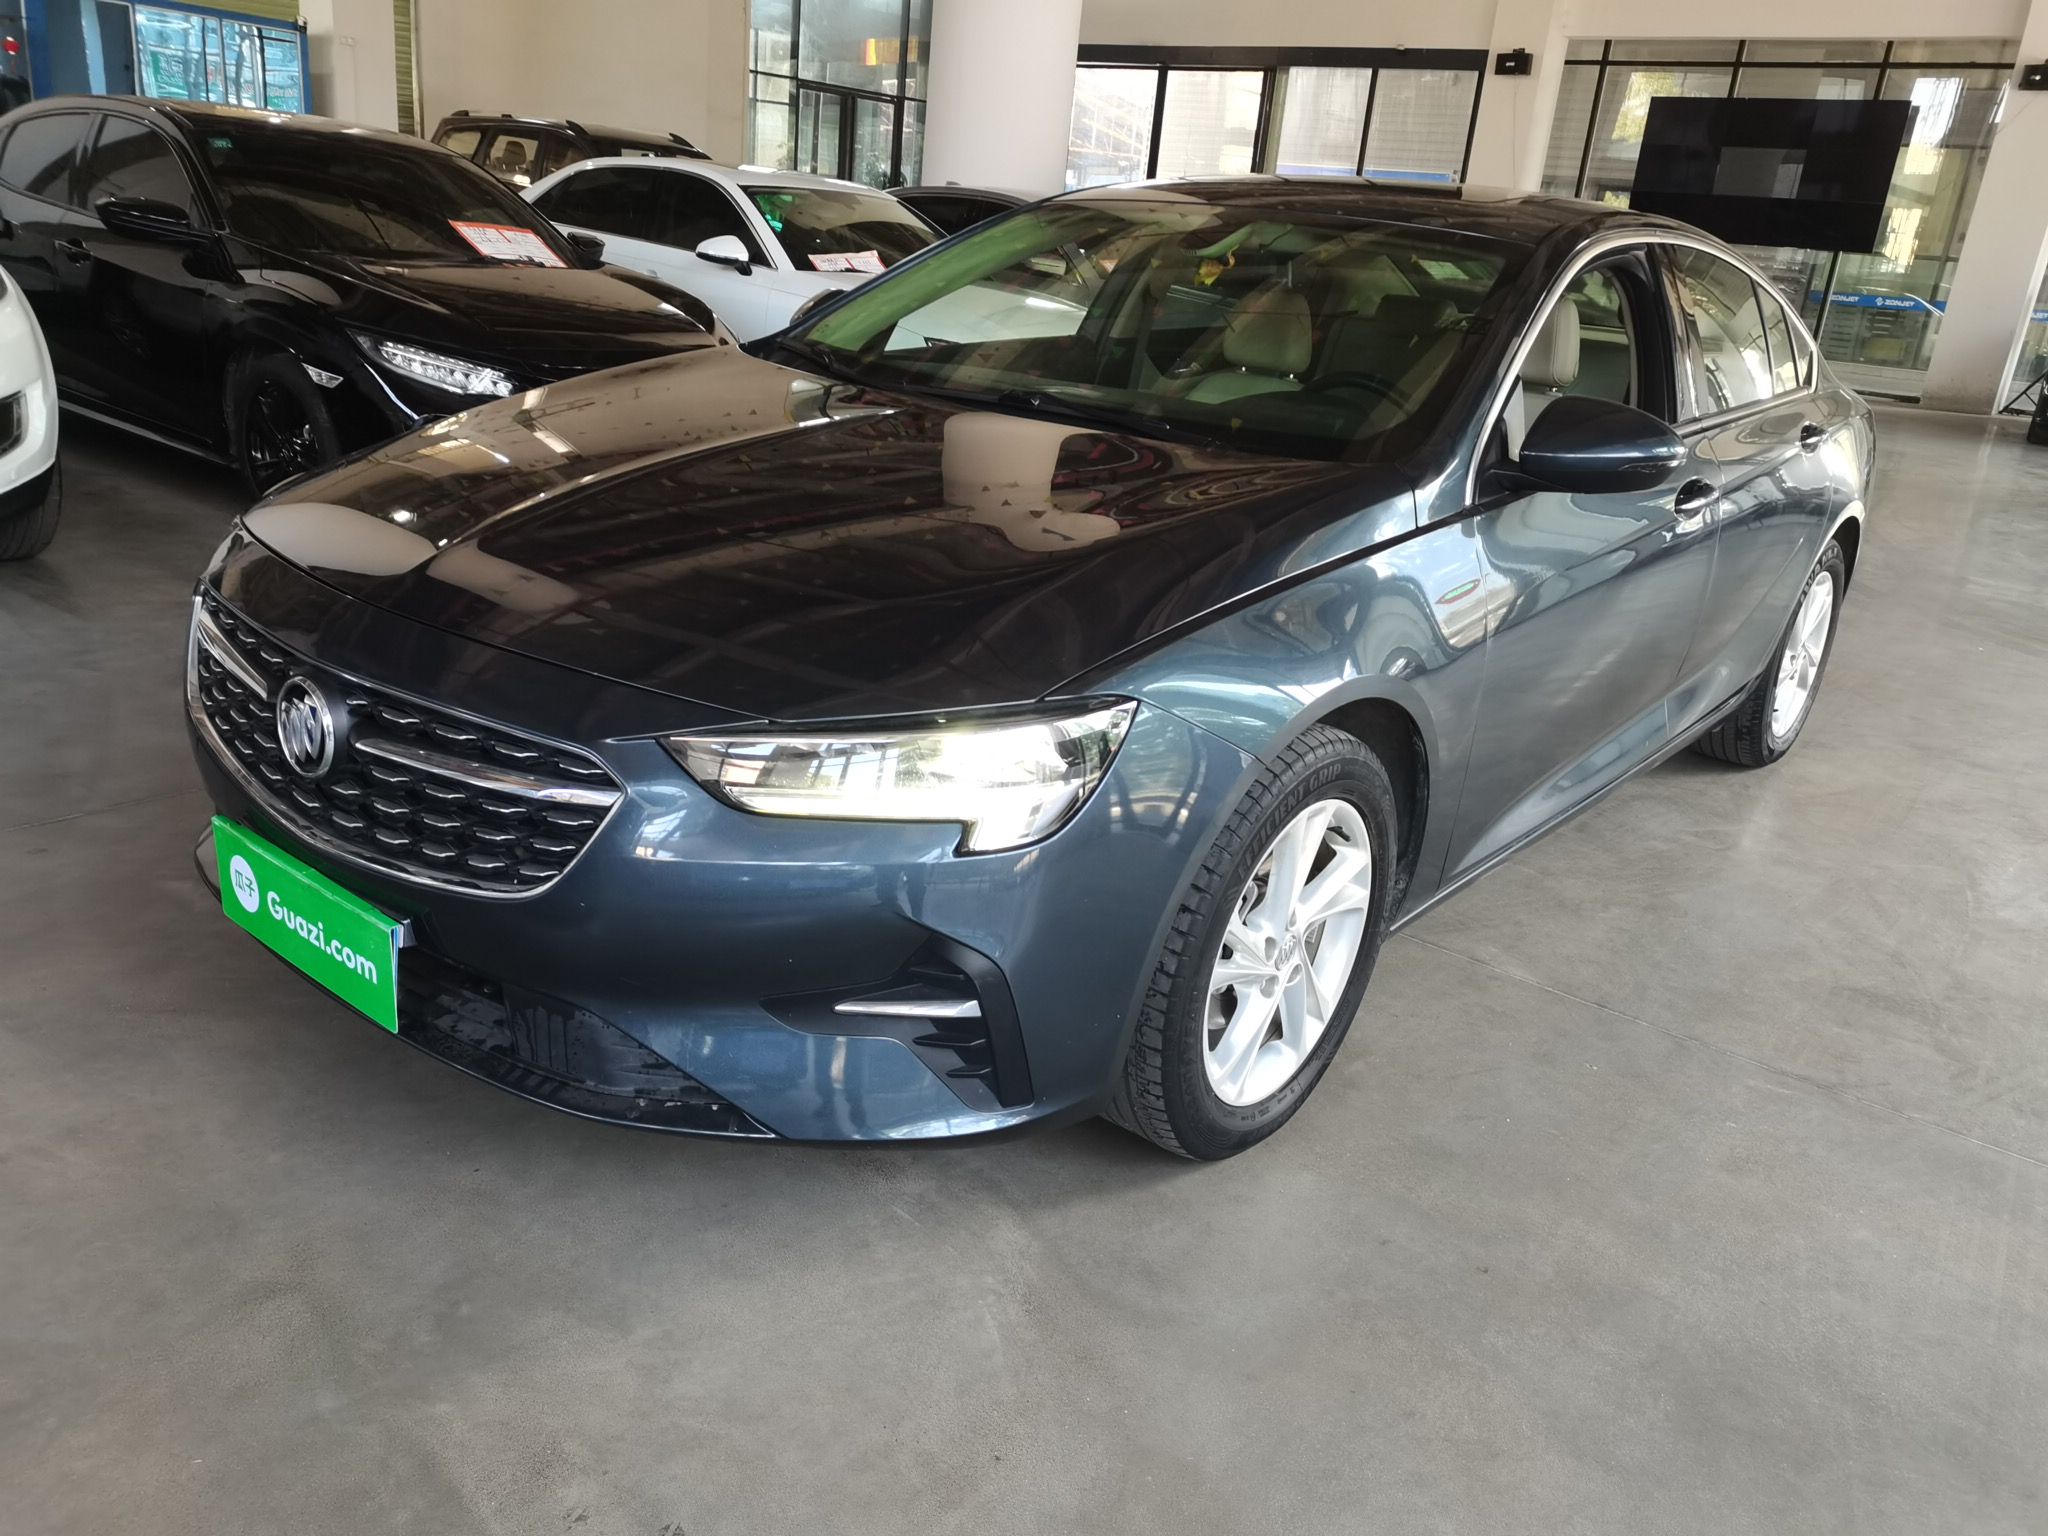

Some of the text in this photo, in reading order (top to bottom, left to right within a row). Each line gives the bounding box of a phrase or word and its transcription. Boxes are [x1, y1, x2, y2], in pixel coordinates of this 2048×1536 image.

[1309, 763, 1341, 790] GRIP
[234, 870, 255, 898] 瓜子
[267, 890, 378, 985] Guazi.com
